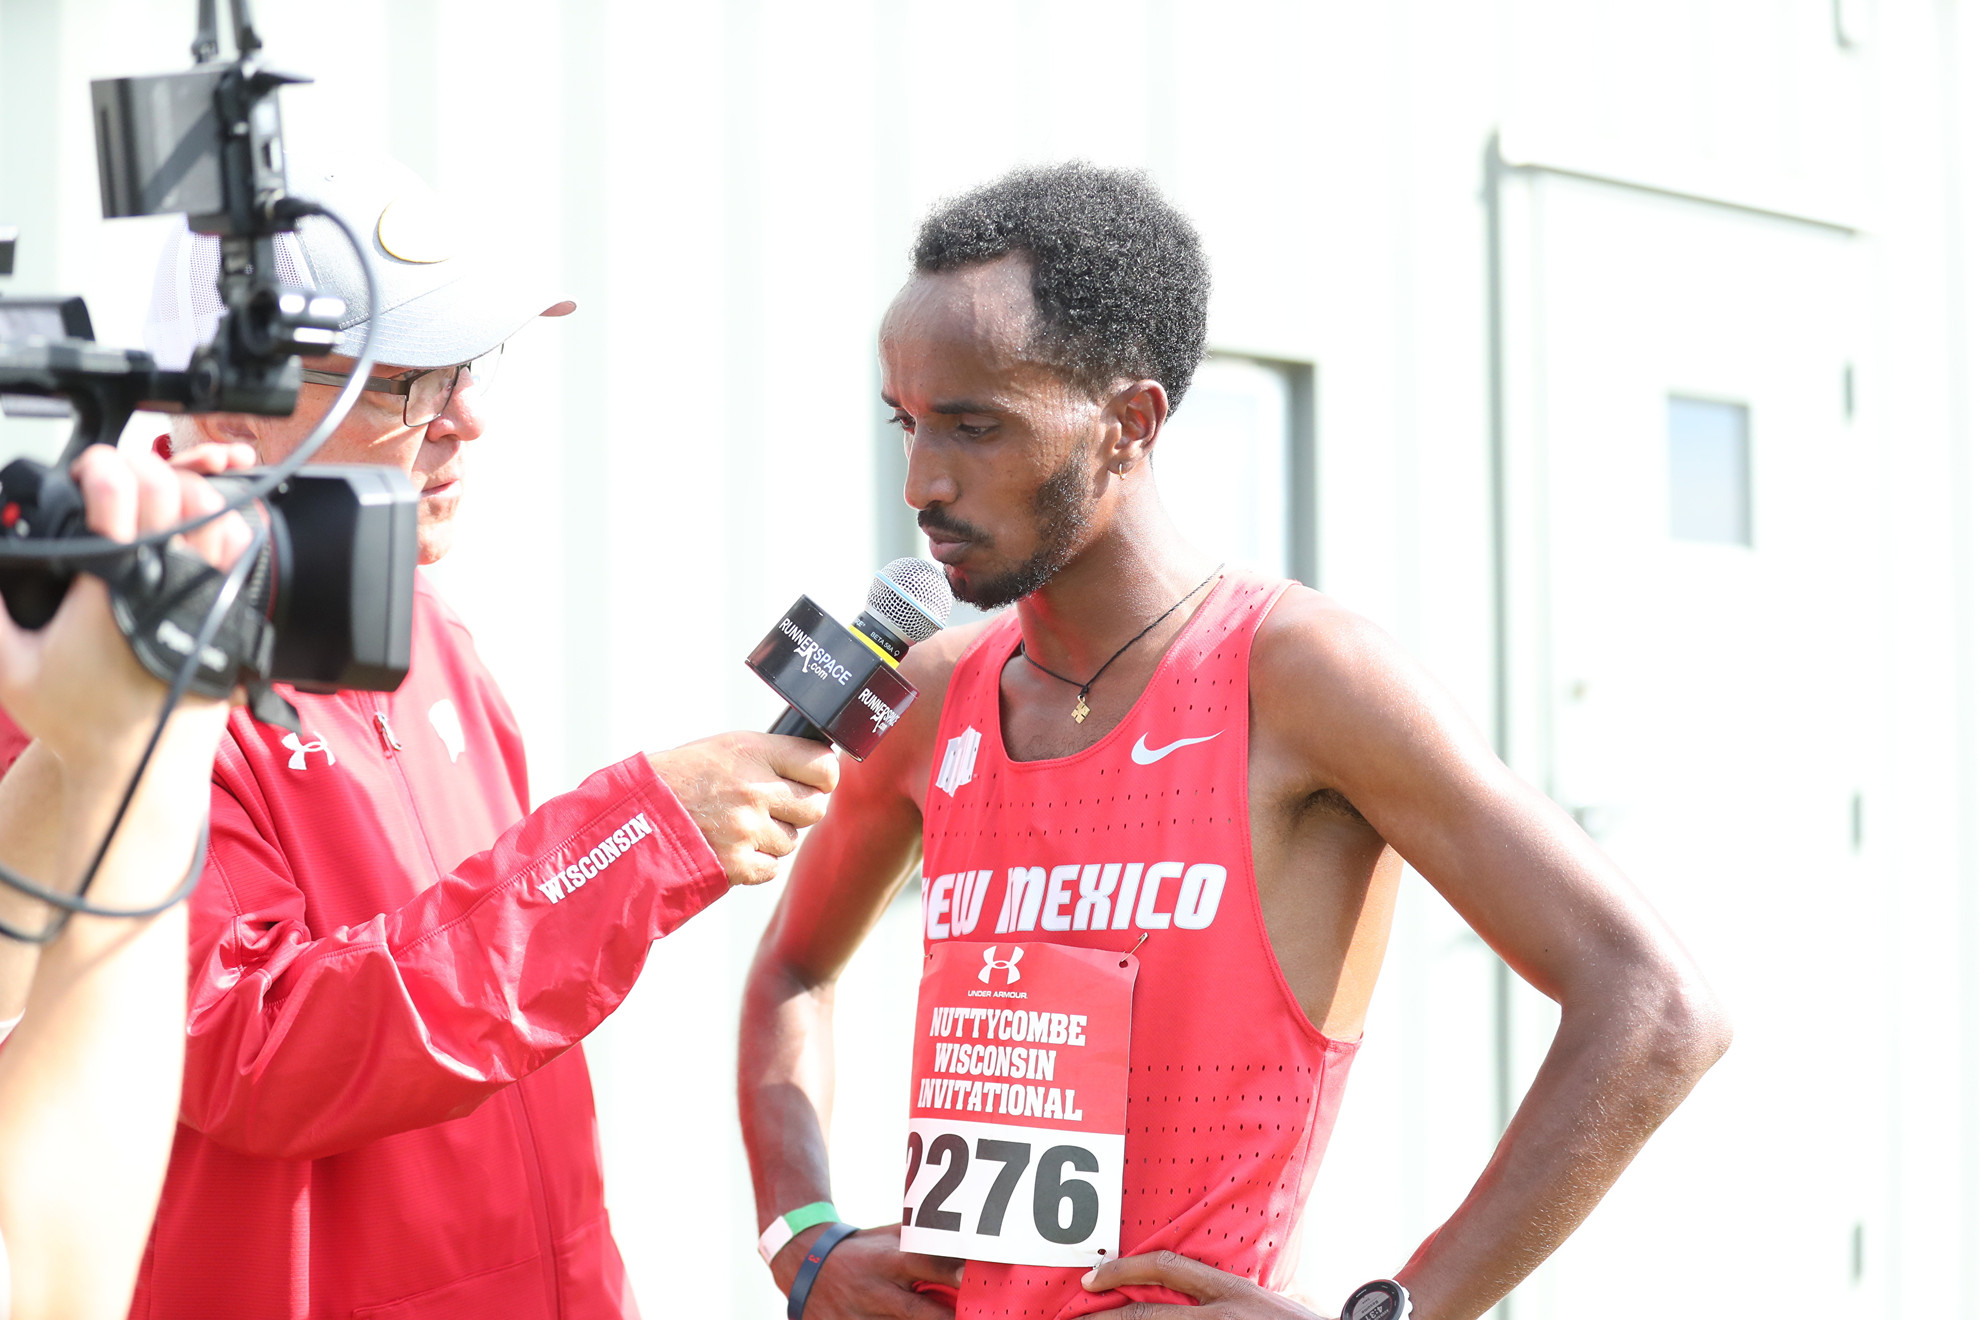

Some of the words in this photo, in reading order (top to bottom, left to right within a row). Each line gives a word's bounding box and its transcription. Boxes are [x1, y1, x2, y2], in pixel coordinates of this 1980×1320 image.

[778, 617, 852, 686] RUNNERSPACE
[870, 631, 885, 645] BETA
[808, 662, 829, 681] .com
[538, 812, 653, 905] WISCONSIN
[994, 861, 1228, 935] MEXICO
[967, 990, 992, 998] UNDER
[929, 1006, 1088, 1047] NUTTYCOMBE
[933, 1042, 1057, 1081] WISCONSIN
[917, 1078, 1083, 1122] INVITATIONAL
[902, 1130, 1100, 1245] 2276
